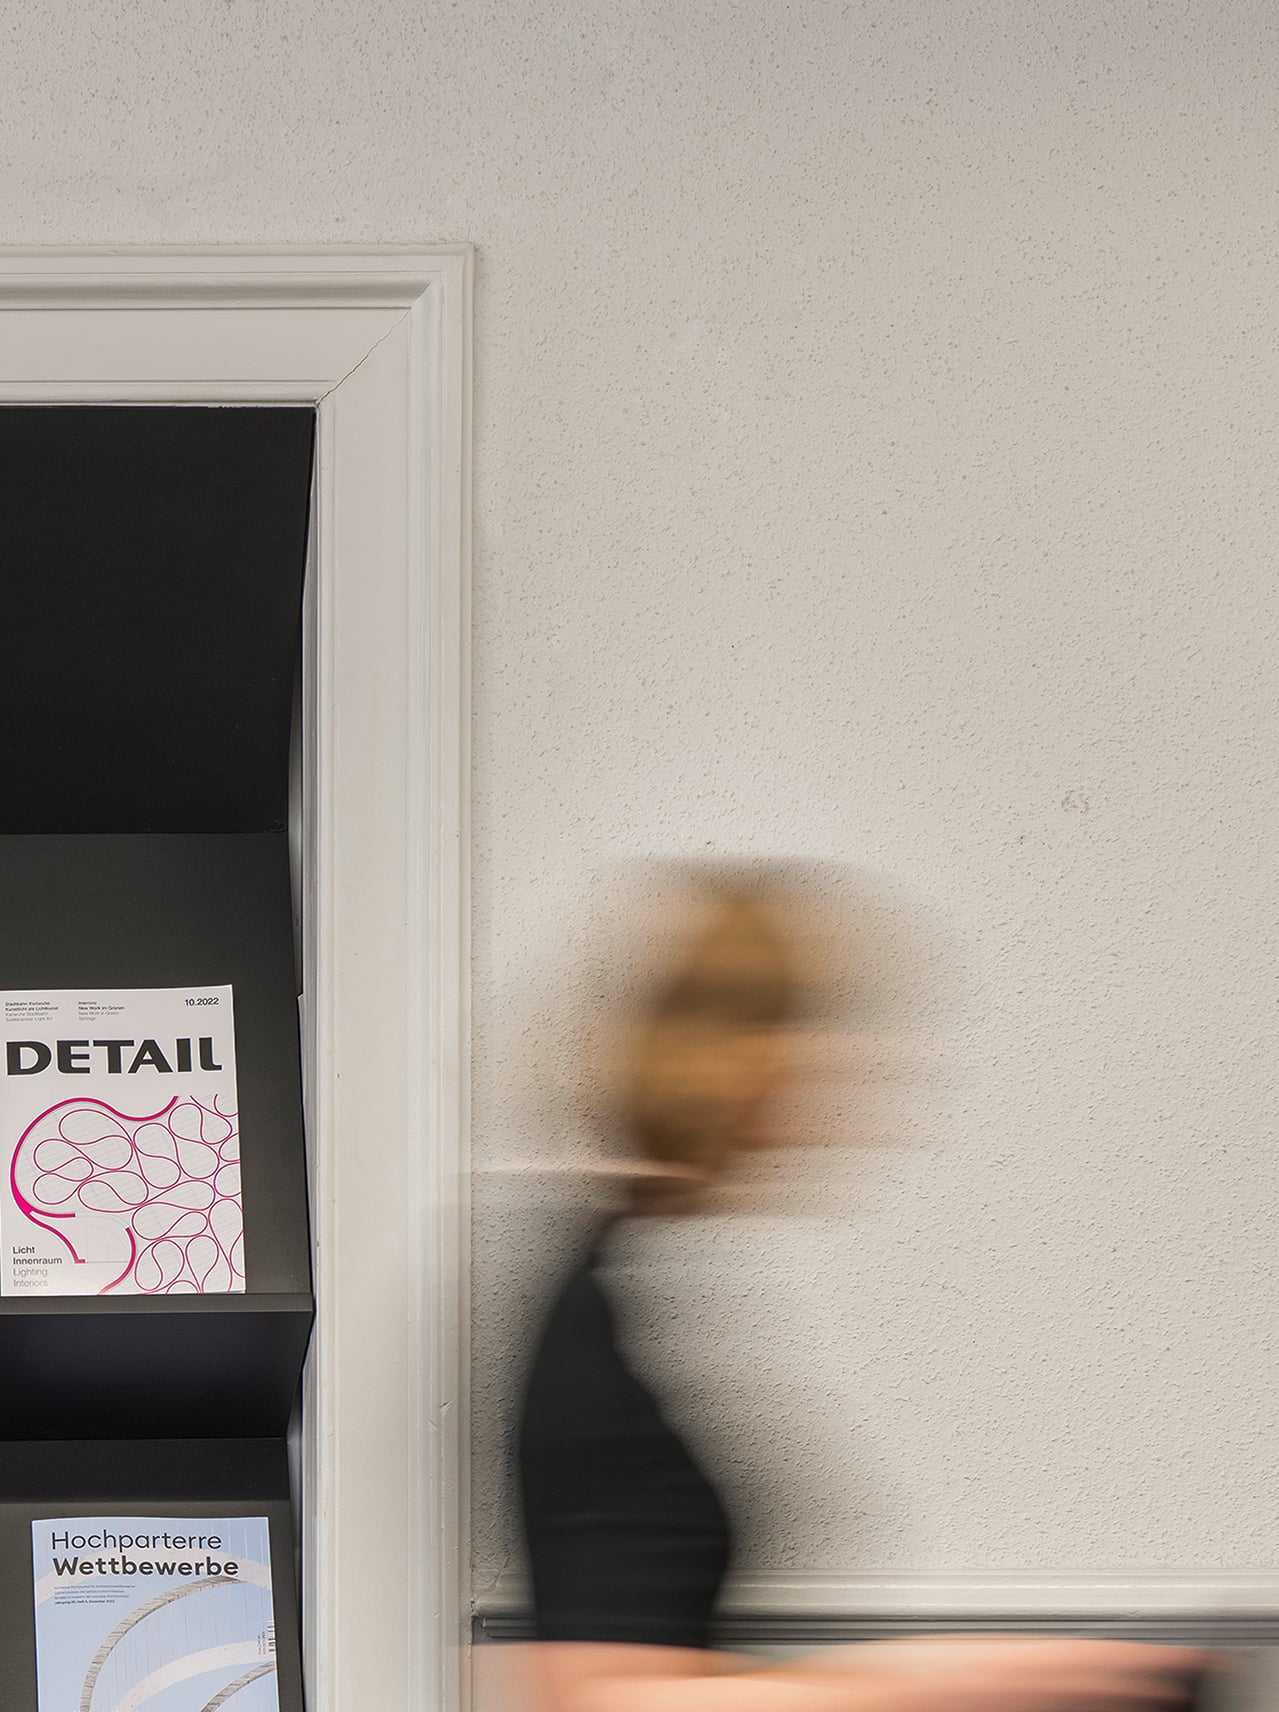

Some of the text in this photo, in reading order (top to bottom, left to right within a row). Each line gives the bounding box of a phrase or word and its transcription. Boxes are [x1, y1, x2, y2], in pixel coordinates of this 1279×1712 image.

[184, 998, 219, 1007] 10.2022
[6, 1036, 222, 1076] DETAIL
[12, 1246, 35, 1254] Licht
[13, 1257, 62, 1265] Innenraum
[13, 1268, 48, 1278] Lighting
[52, 1529, 222, 1552] Hochparterre
[52, 1555, 238, 1576] Wettbewerbe
